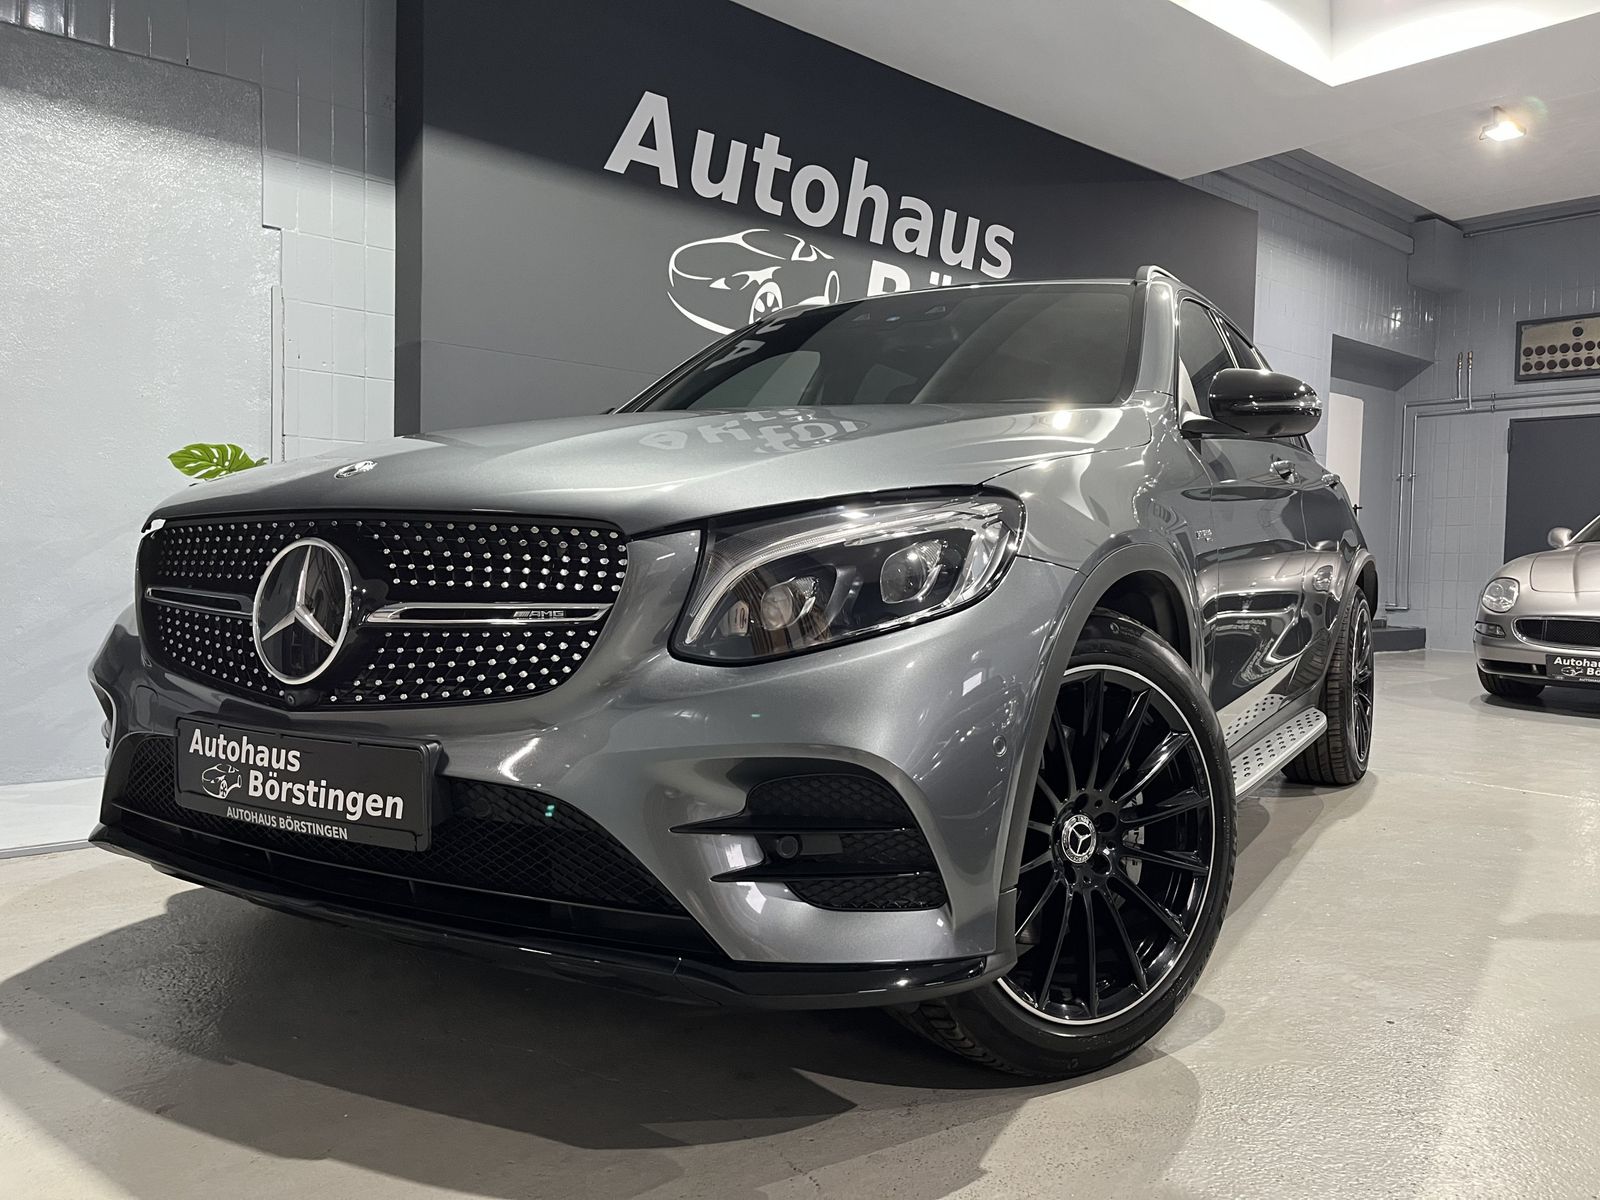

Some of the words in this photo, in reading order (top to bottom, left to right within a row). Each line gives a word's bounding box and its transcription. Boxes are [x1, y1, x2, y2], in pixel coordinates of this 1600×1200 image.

[603, 90, 1015, 279] Autohaus
[528, 610, 564, 618] AMG
[1553, 656, 1600, 668] Autoha
[189, 728, 301, 772] Autohaus
[248, 769, 404, 821] Börstingen
[226, 806, 277, 828] AUTOHAUS
[279, 815, 348, 840] BÖRSTINGEN
